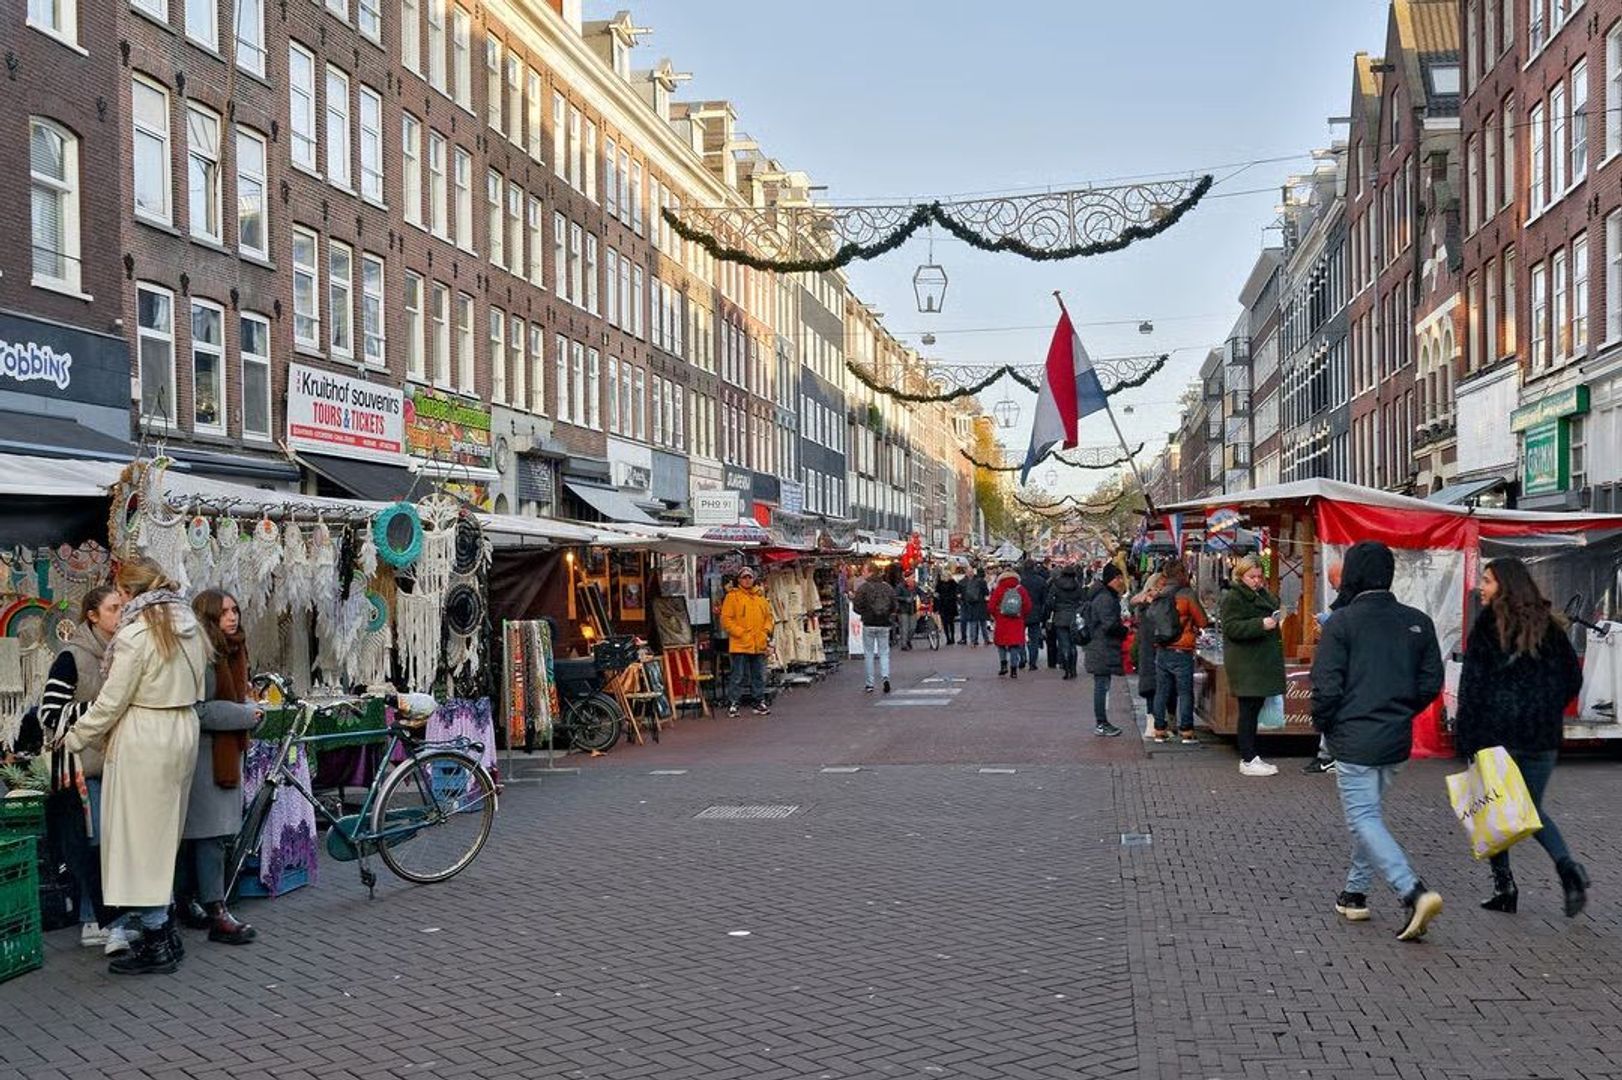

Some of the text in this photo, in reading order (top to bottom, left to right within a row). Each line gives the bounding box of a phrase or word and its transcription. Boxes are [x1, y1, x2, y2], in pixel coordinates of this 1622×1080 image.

[302, 371, 350, 404] Kruithof
[351, 388, 400, 415] souvenirs
[312, 401, 385, 435] TOURS & TICKETS
